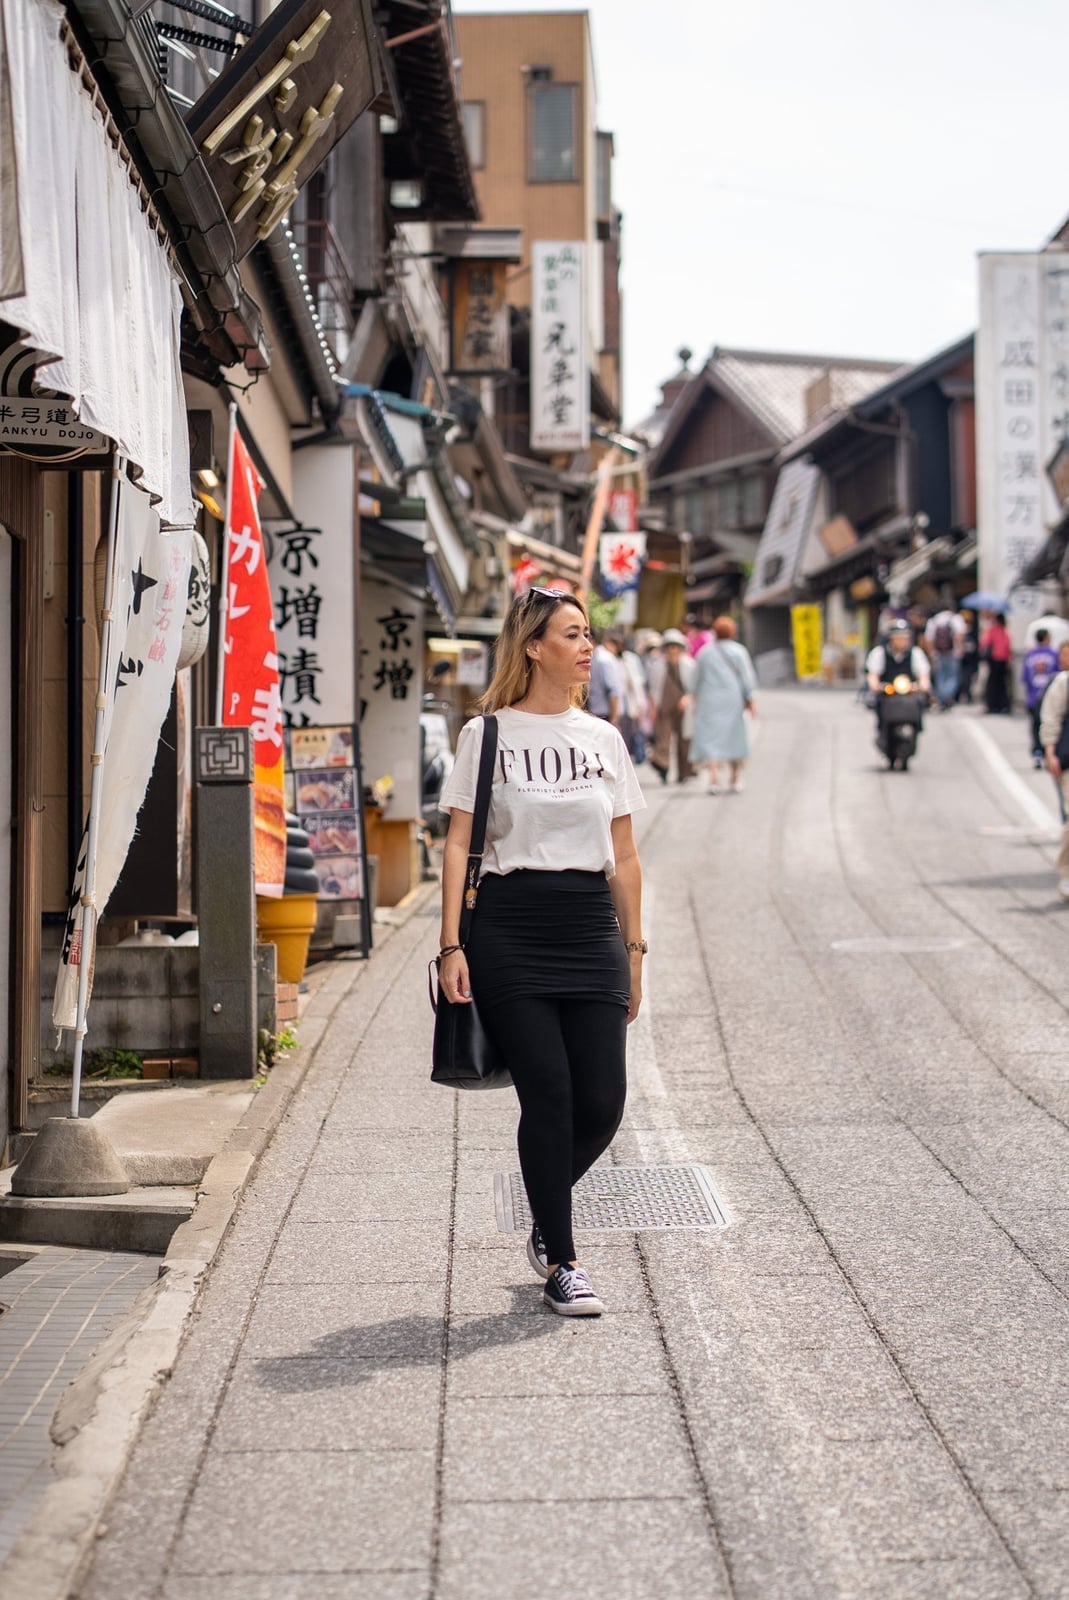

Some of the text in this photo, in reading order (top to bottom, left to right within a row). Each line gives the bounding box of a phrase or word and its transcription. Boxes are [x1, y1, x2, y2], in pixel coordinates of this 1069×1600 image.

[0, 404, 81, 426] 半弓道
[0, 426, 95, 440] ANKYU DOJO
[374, 608, 417, 700] 京増
